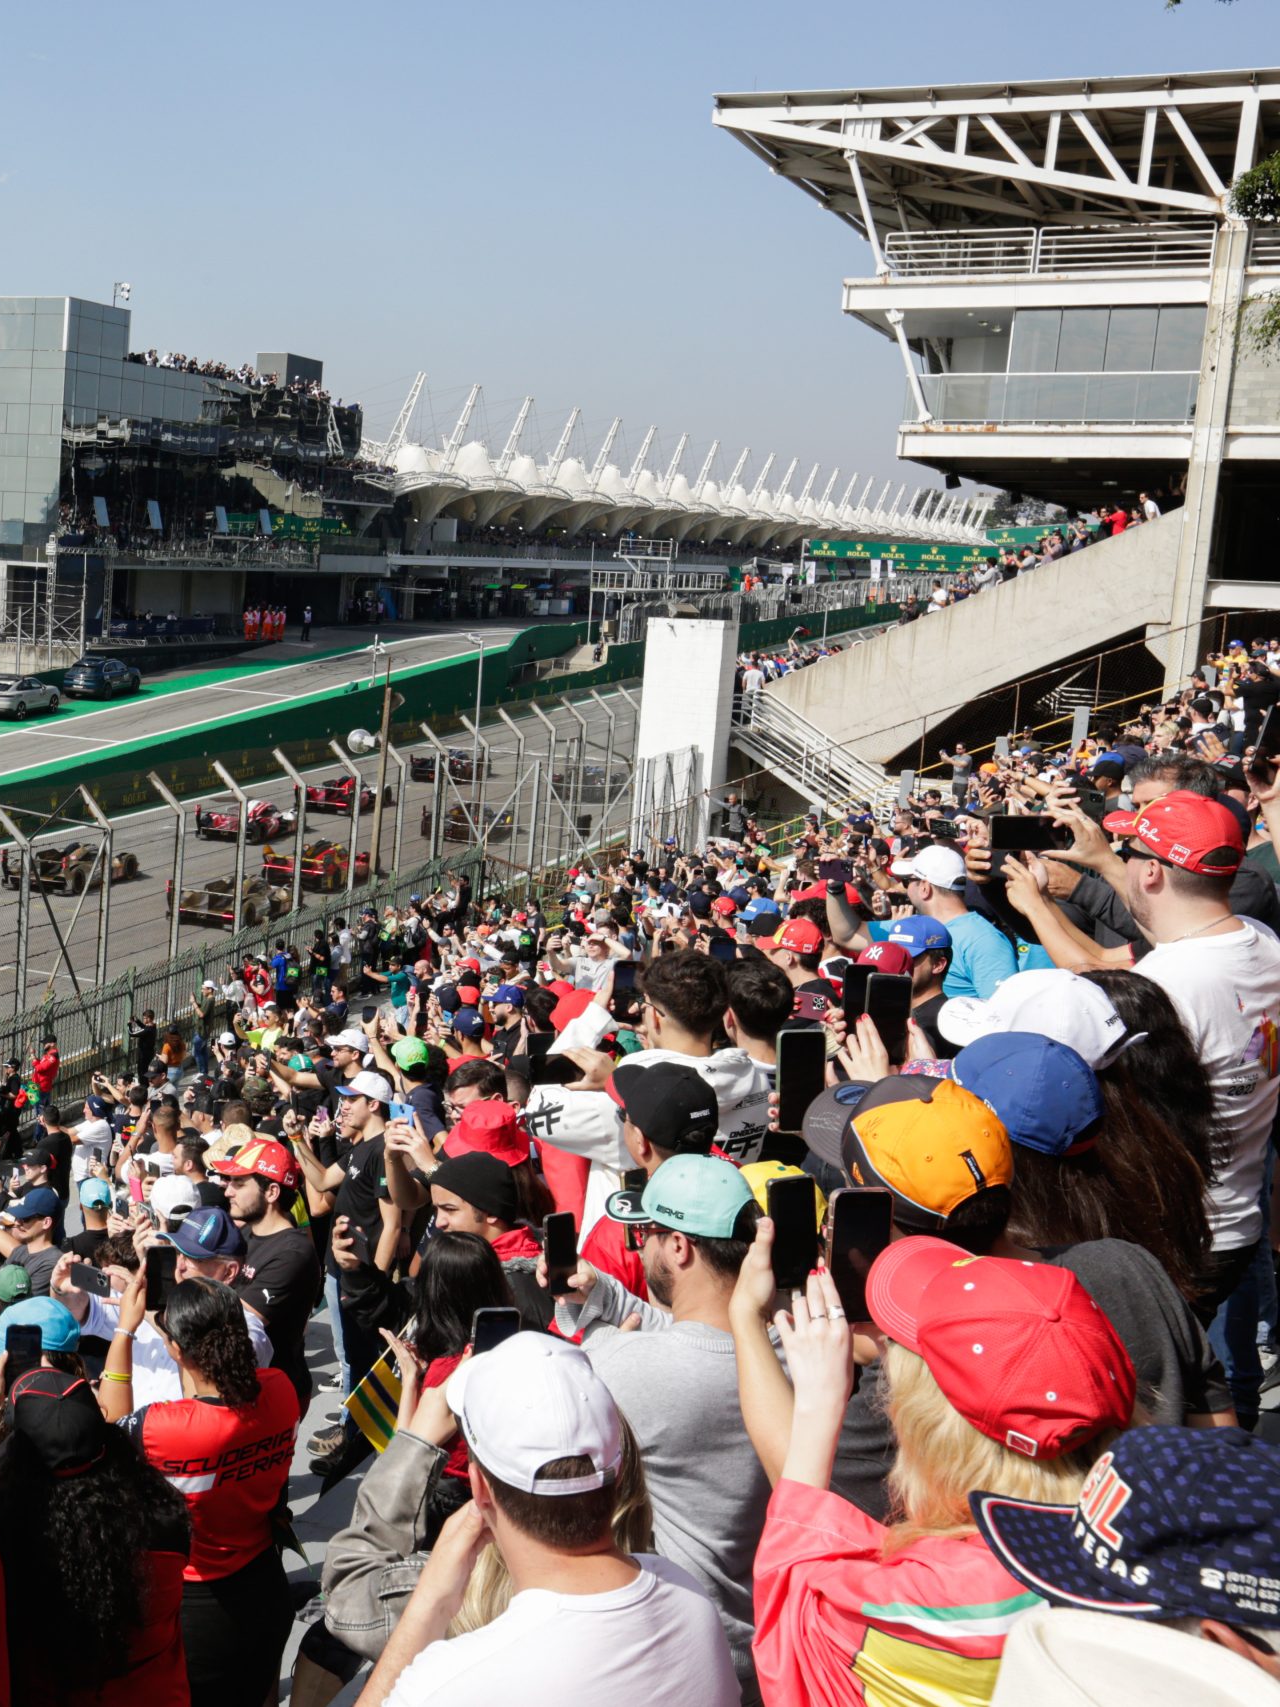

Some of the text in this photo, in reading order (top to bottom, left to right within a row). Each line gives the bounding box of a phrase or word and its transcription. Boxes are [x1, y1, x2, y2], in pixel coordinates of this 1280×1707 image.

[162, 1427, 294, 1475] SCUDERIA
[1074, 1521, 1151, 1586] PEÇAS
[1236, 1598, 1278, 1615] JALES
